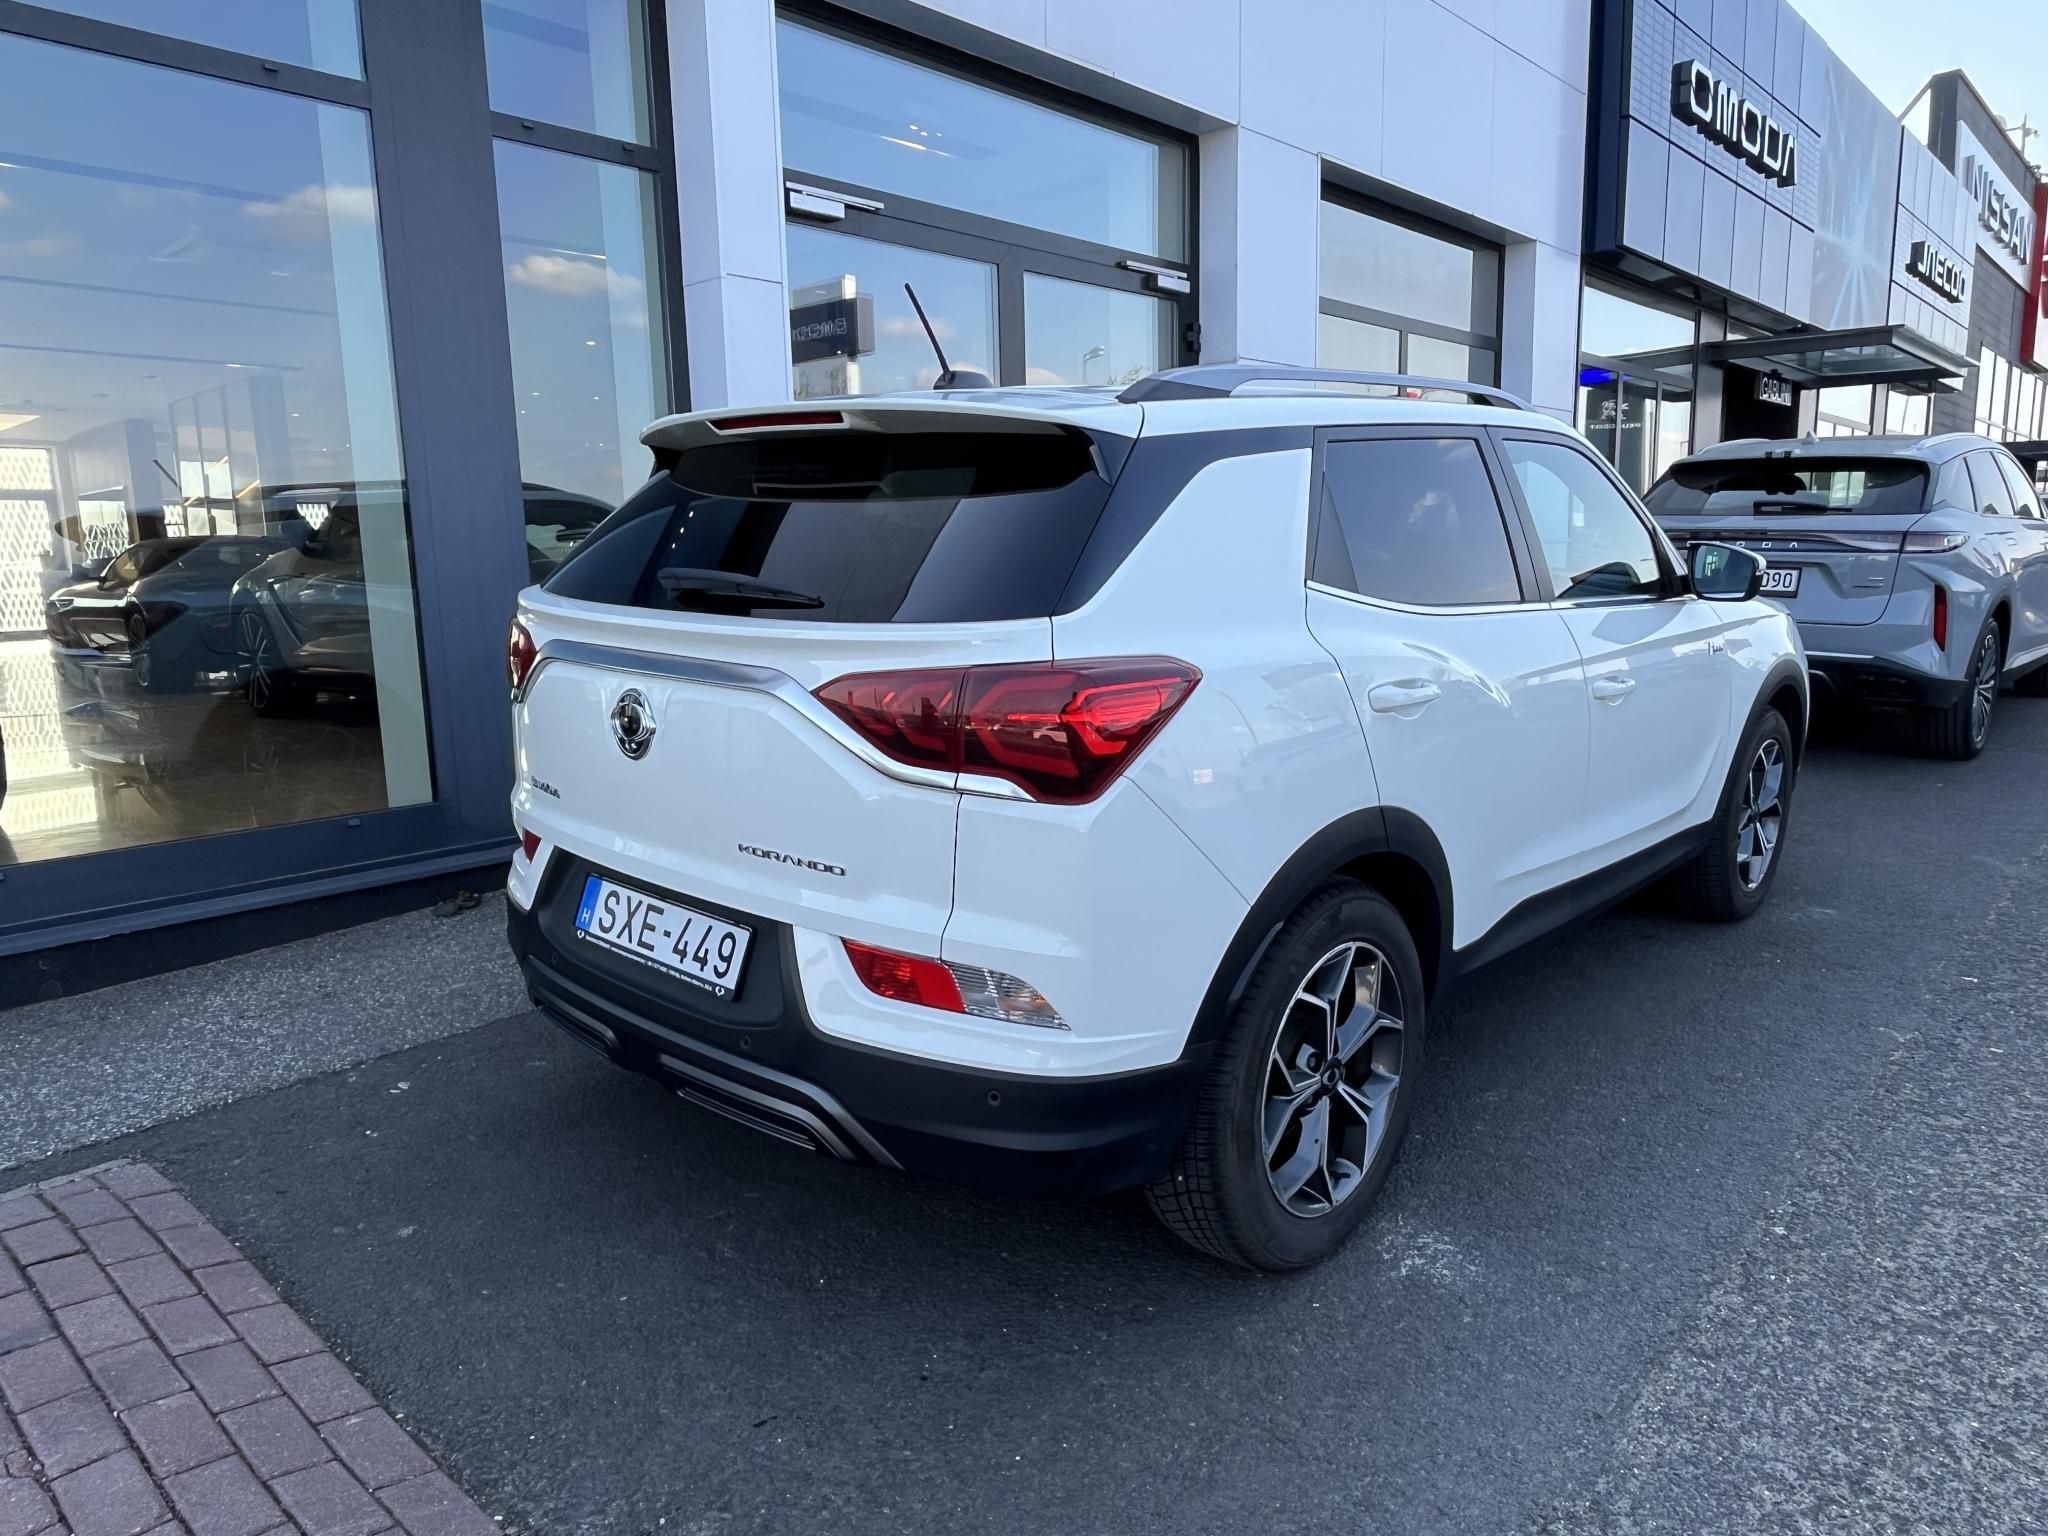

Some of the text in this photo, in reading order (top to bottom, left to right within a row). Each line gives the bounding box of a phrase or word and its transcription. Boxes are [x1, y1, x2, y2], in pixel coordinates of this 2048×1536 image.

[1681, 59, 1798, 186] OMODA
[1969, 154, 2034, 265] NISSAN
[1911, 241, 1967, 302] JAECOO
[738, 843, 846, 876] KORANDO
[581, 908, 591, 924] H
[598, 889, 737, 980] SXE-449
